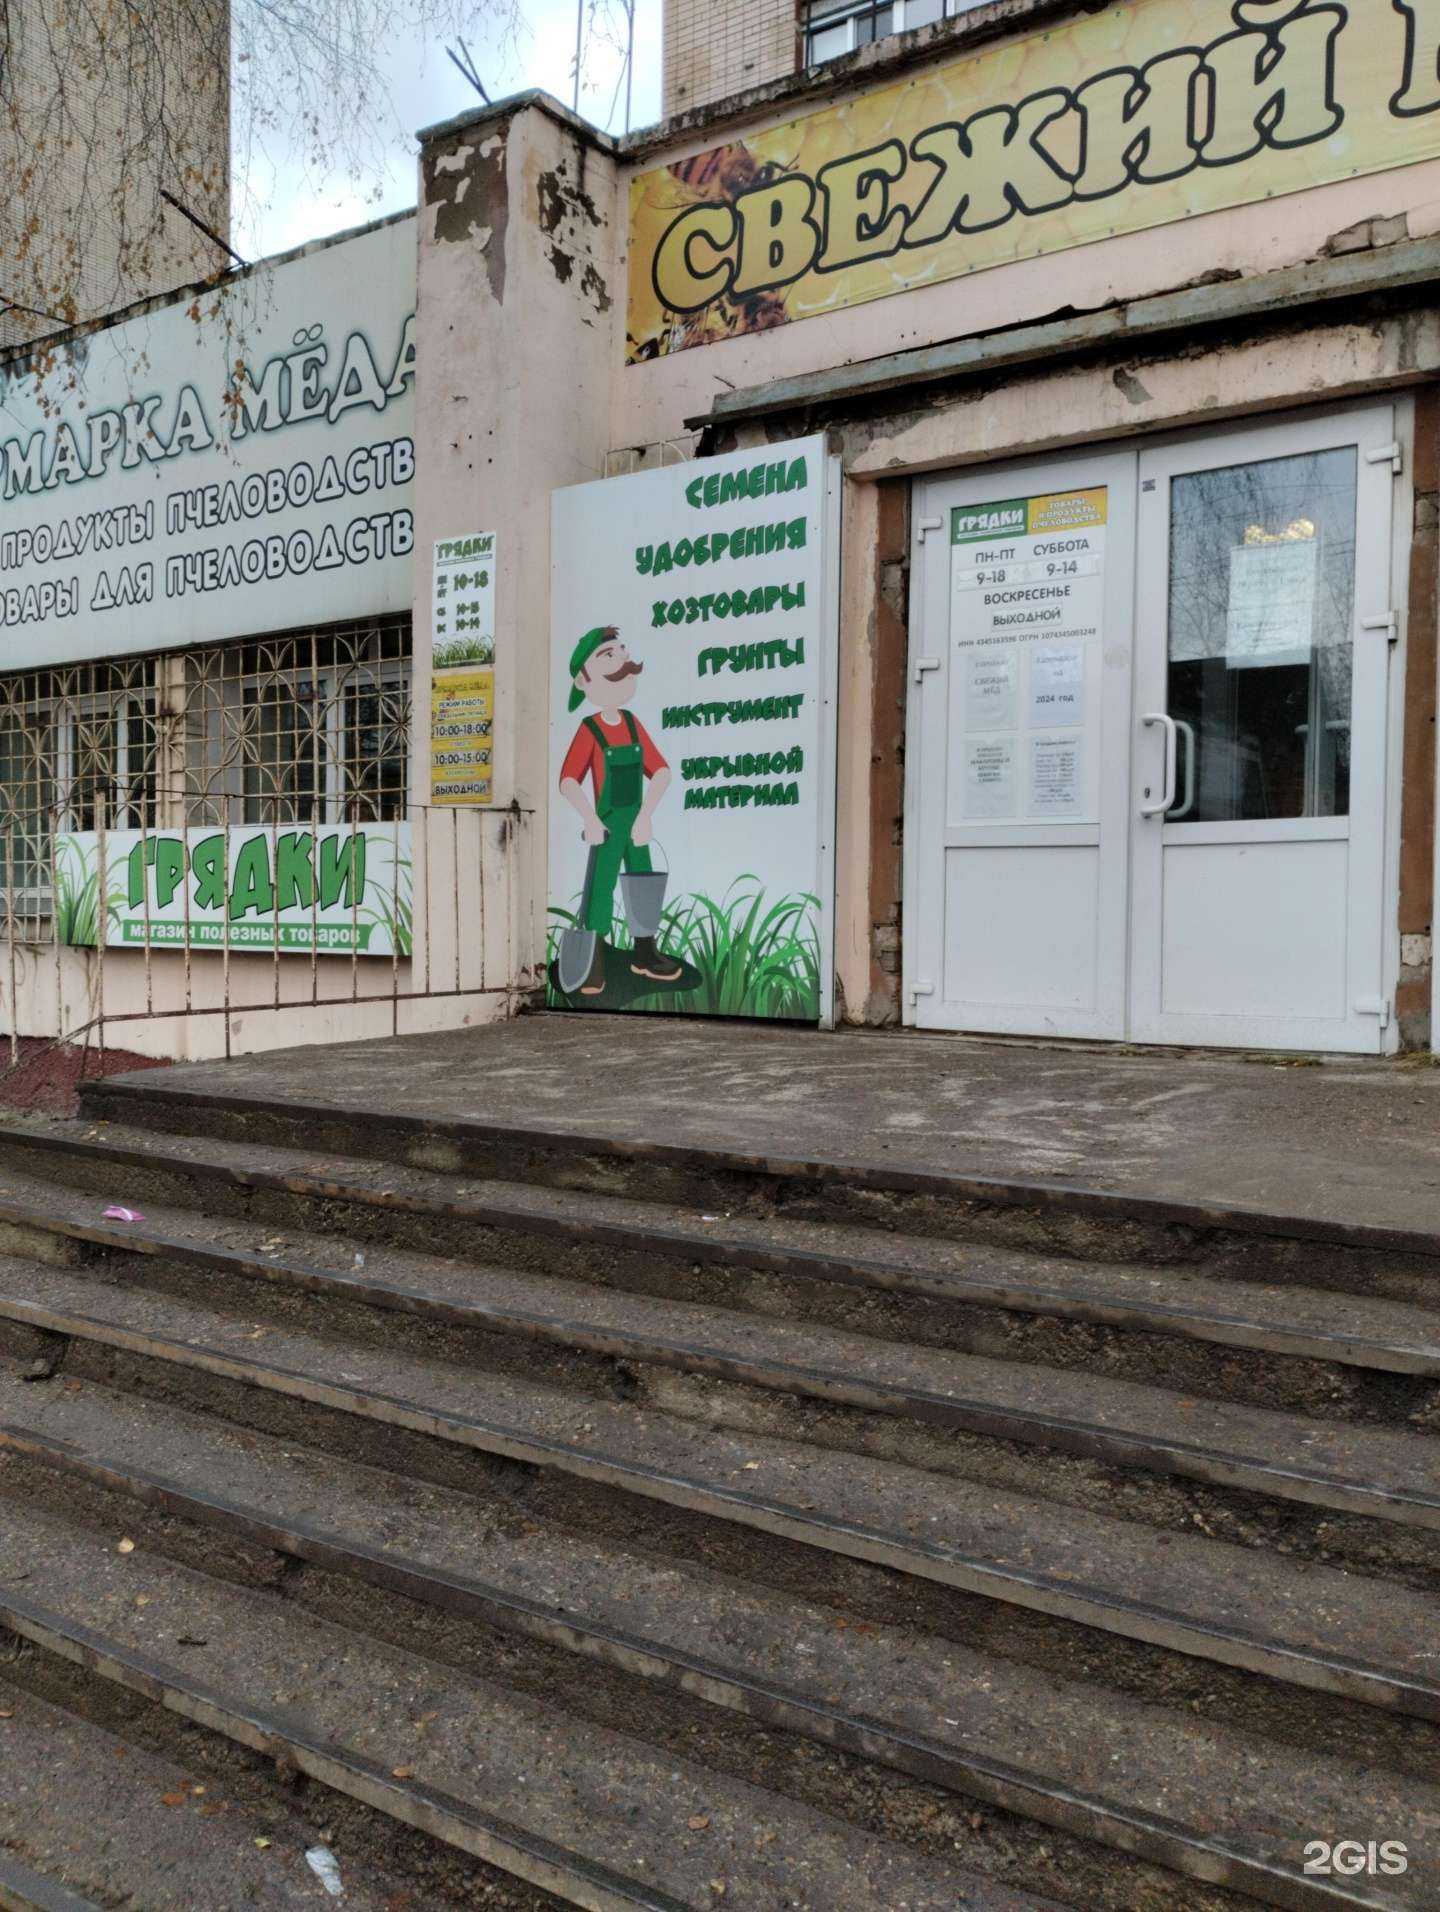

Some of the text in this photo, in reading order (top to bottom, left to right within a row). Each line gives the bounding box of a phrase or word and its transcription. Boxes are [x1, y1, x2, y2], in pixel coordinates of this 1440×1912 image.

[652, 0, 1348, 314] СВЕЖИЙ
[0, 384, 214, 501] МАРКА
[685, 456, 808, 509] СЕМЕНА
[1, 437, 415, 570] ПРОДУКТЫ ПЧЕЛОВОДСТВ
[958, 508, 1024, 532] ГРЯДКИ
[90, 562, 153, 611] ДЛЯ
[166, 509, 415, 597] ПЧЕЛОВОДСТВ
[635, 516, 808, 577] УДОБРЕНИЯ
[975, 539, 1090, 564] ПН-ПТ СУББОТА
[453, 570, 489, 592] 10-18
[976, 560, 1078, 585] 9-18 9-14
[651, 580, 806, 628] ХОЗТОВАРЫ
[983, 585, 1071, 606] ВОСКРЕСЕНЬЕ
[992, 608, 1062, 626] ВЫХОДНОЙ
[1018, 633, 1039, 642] ОГРН
[697, 637, 805, 678] ГРУНТЫ
[435, 722, 487, 737] 10:00-18:00
[661, 693, 805, 730] ИНСТРУМЕНТ
[435, 751, 488, 765] 10:00-15:00
[680, 745, 804, 782] УКРЫВНОЙ
[683, 781, 800, 810] МАТЕРИАЛ
[128, 831, 366, 921] ГРЯДКИ
